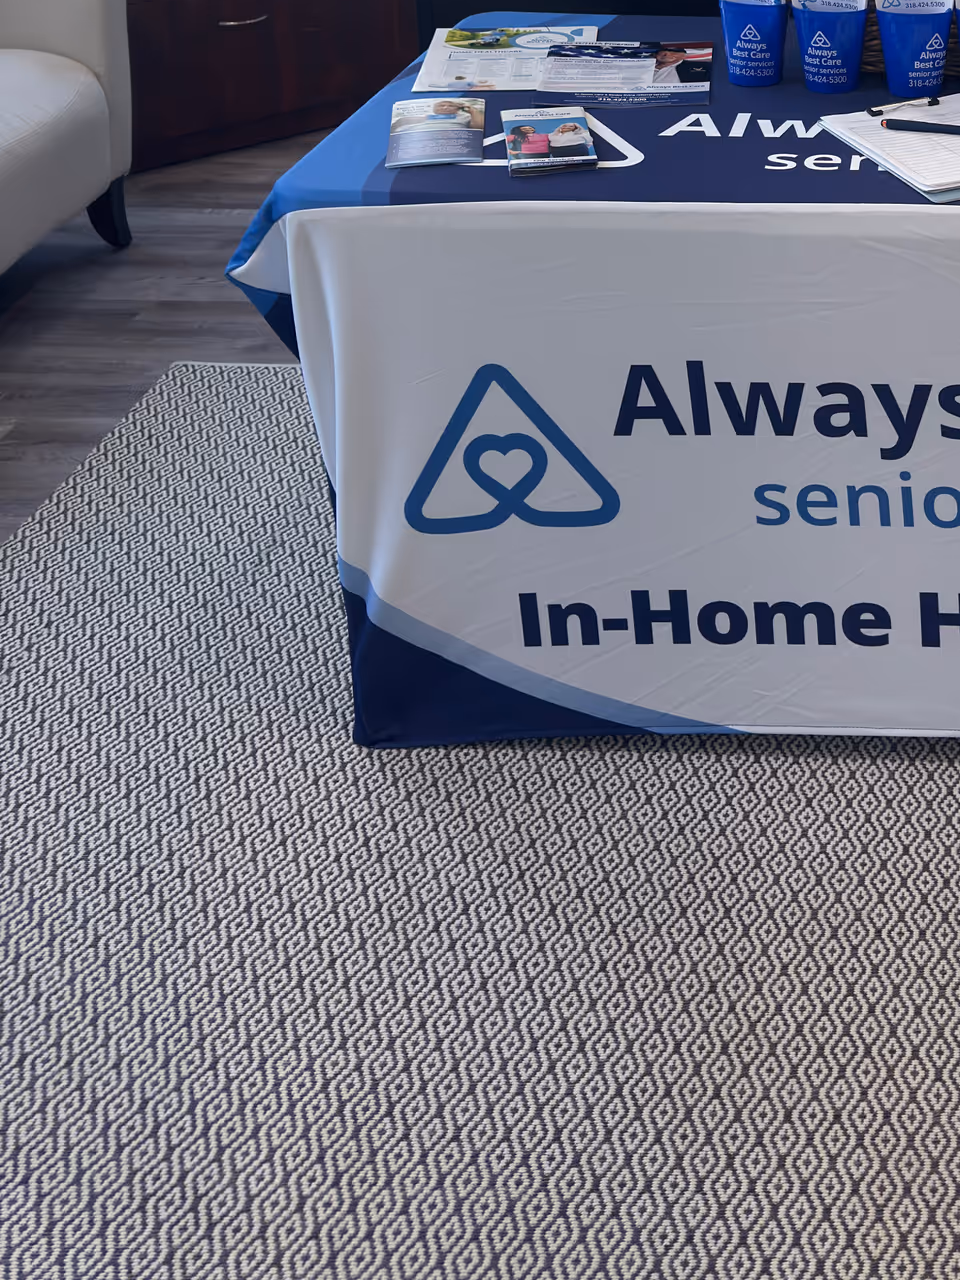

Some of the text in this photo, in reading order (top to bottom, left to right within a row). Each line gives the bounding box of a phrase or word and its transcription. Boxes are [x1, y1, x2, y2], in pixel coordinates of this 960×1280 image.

[736, 40, 766, 50] Always
[732, 49, 770, 58] Best Care
[807, 47, 837, 57] Always
[805, 55, 841, 66] Best Care
[658, 113, 824, 138] Alw
[517, 588, 892, 647] In-Home
